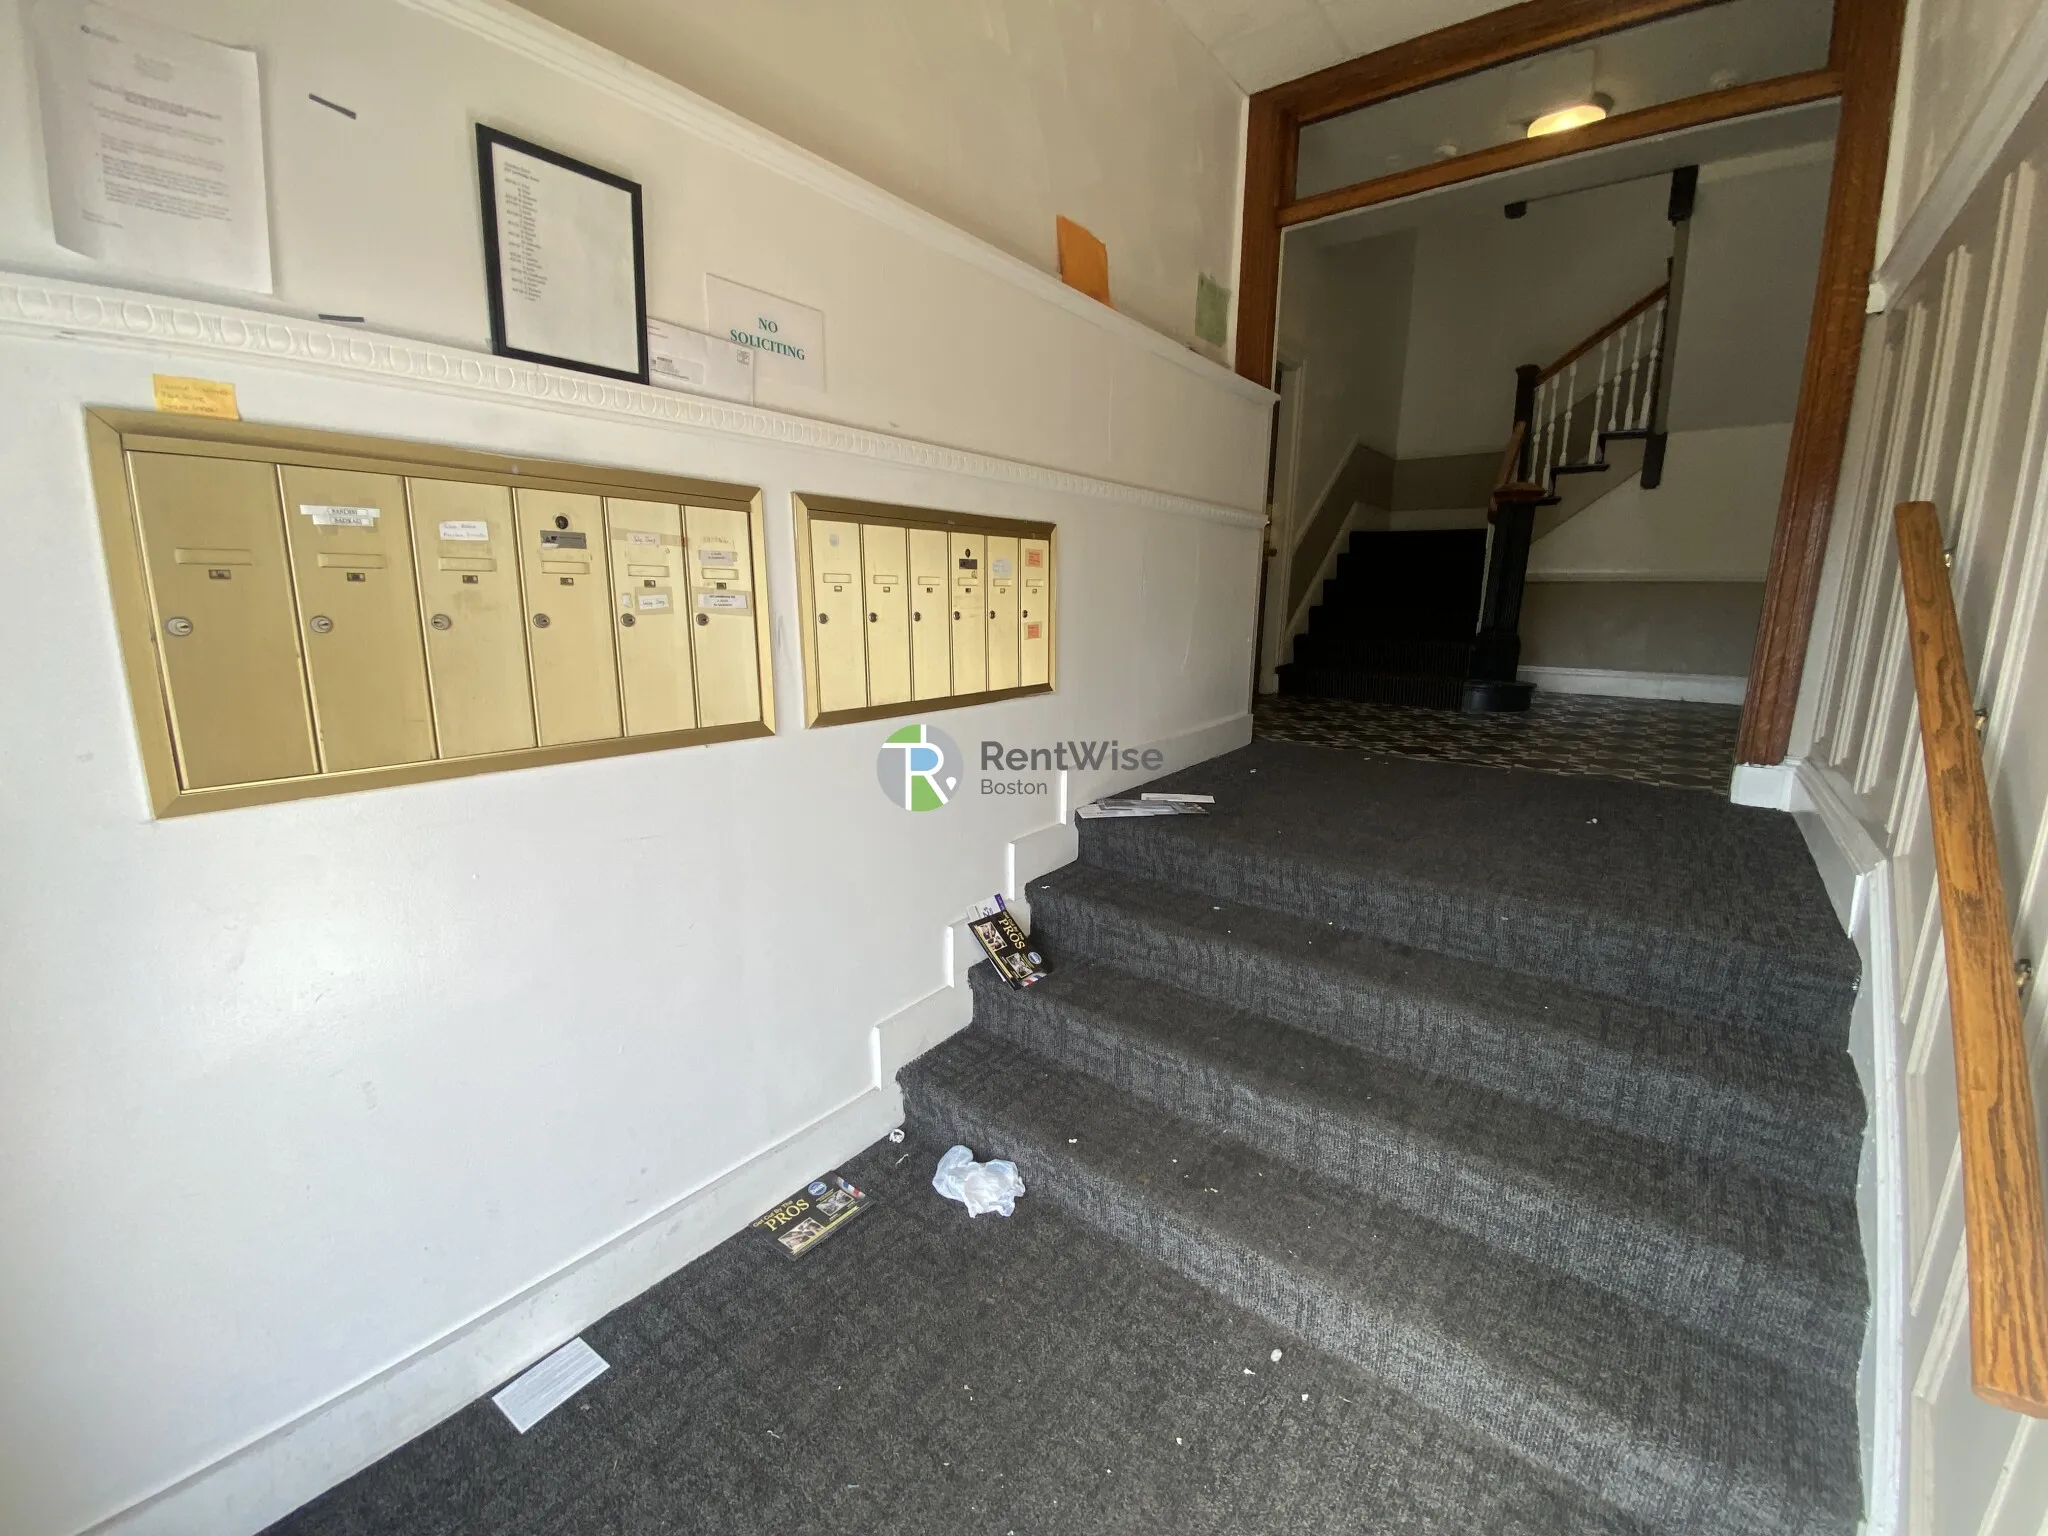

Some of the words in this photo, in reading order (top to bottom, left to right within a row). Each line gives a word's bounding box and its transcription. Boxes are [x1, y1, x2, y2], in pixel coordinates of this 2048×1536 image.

[758, 317, 778, 334] NO
[730, 329, 805, 361] SOLICITING
[998, 918, 1026, 949] PROS
[763, 1198, 810, 1232] PROS
